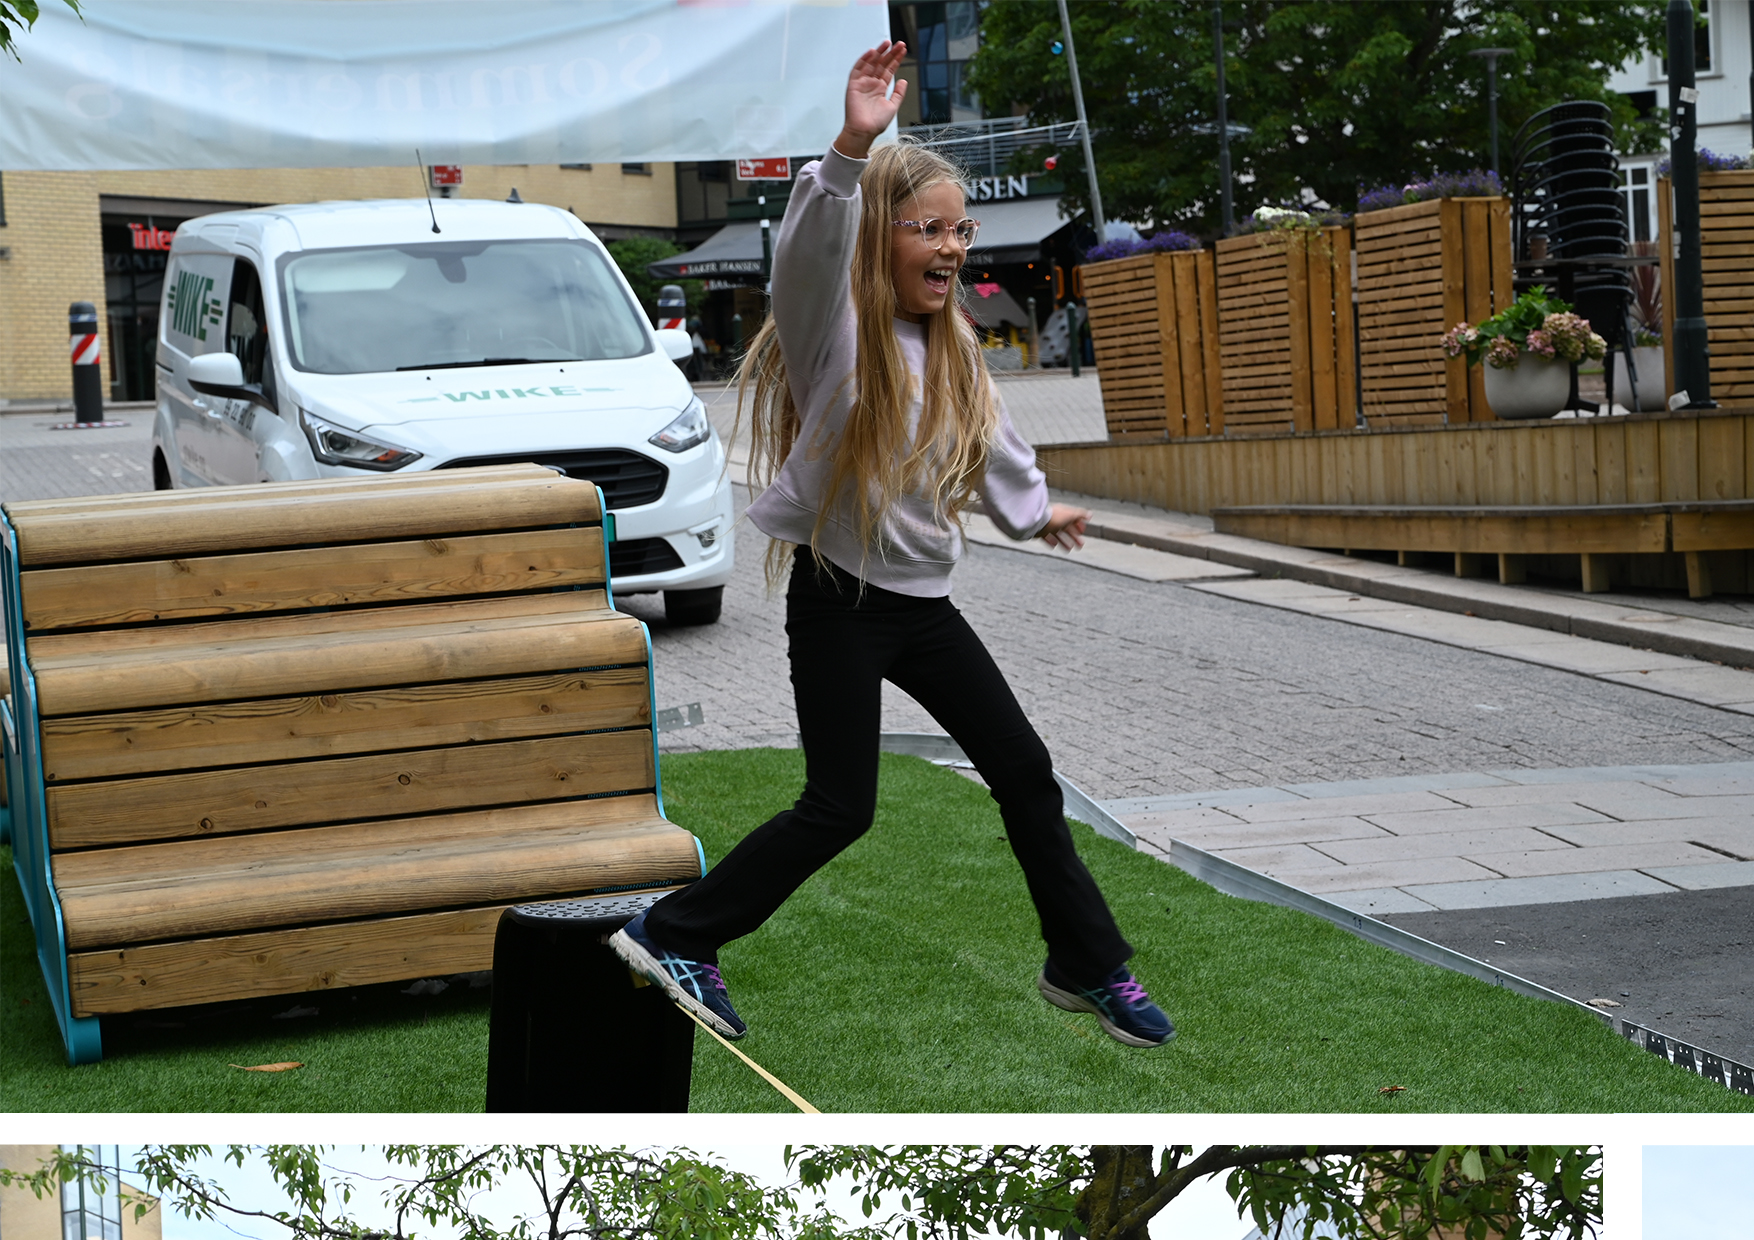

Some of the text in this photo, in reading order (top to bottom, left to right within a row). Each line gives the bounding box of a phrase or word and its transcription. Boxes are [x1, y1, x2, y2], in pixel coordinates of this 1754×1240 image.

[965, 175, 1028, 201] NSEN
[130, 222, 176, 251] inte
[173, 270, 214, 342] WIKE
[443, 384, 582, 403] WIKE
